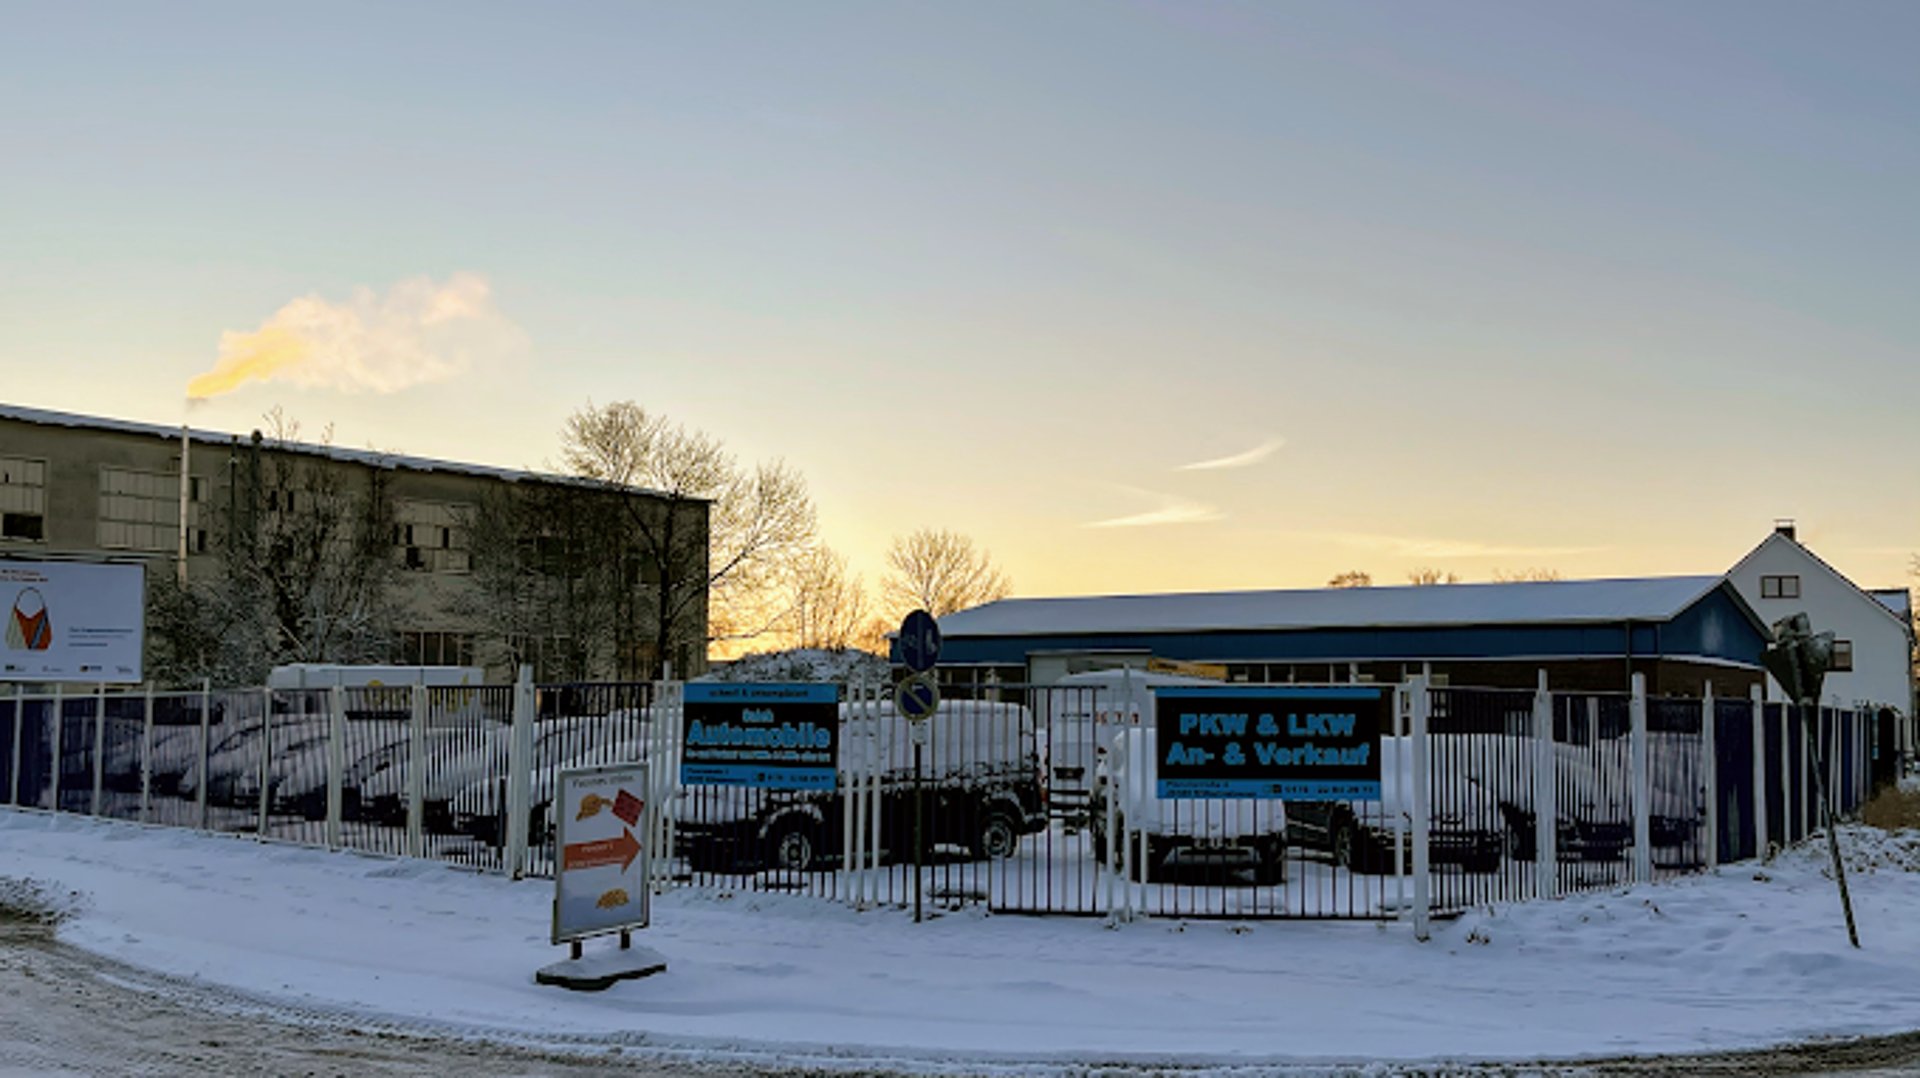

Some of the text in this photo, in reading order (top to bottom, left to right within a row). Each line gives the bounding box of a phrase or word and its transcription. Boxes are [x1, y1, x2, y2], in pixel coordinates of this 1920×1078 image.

[686, 719, 831, 748] Automobile
[1179, 713, 1357, 737] PKW & LKW
[1165, 742, 1370, 765] An- & Verkauf
